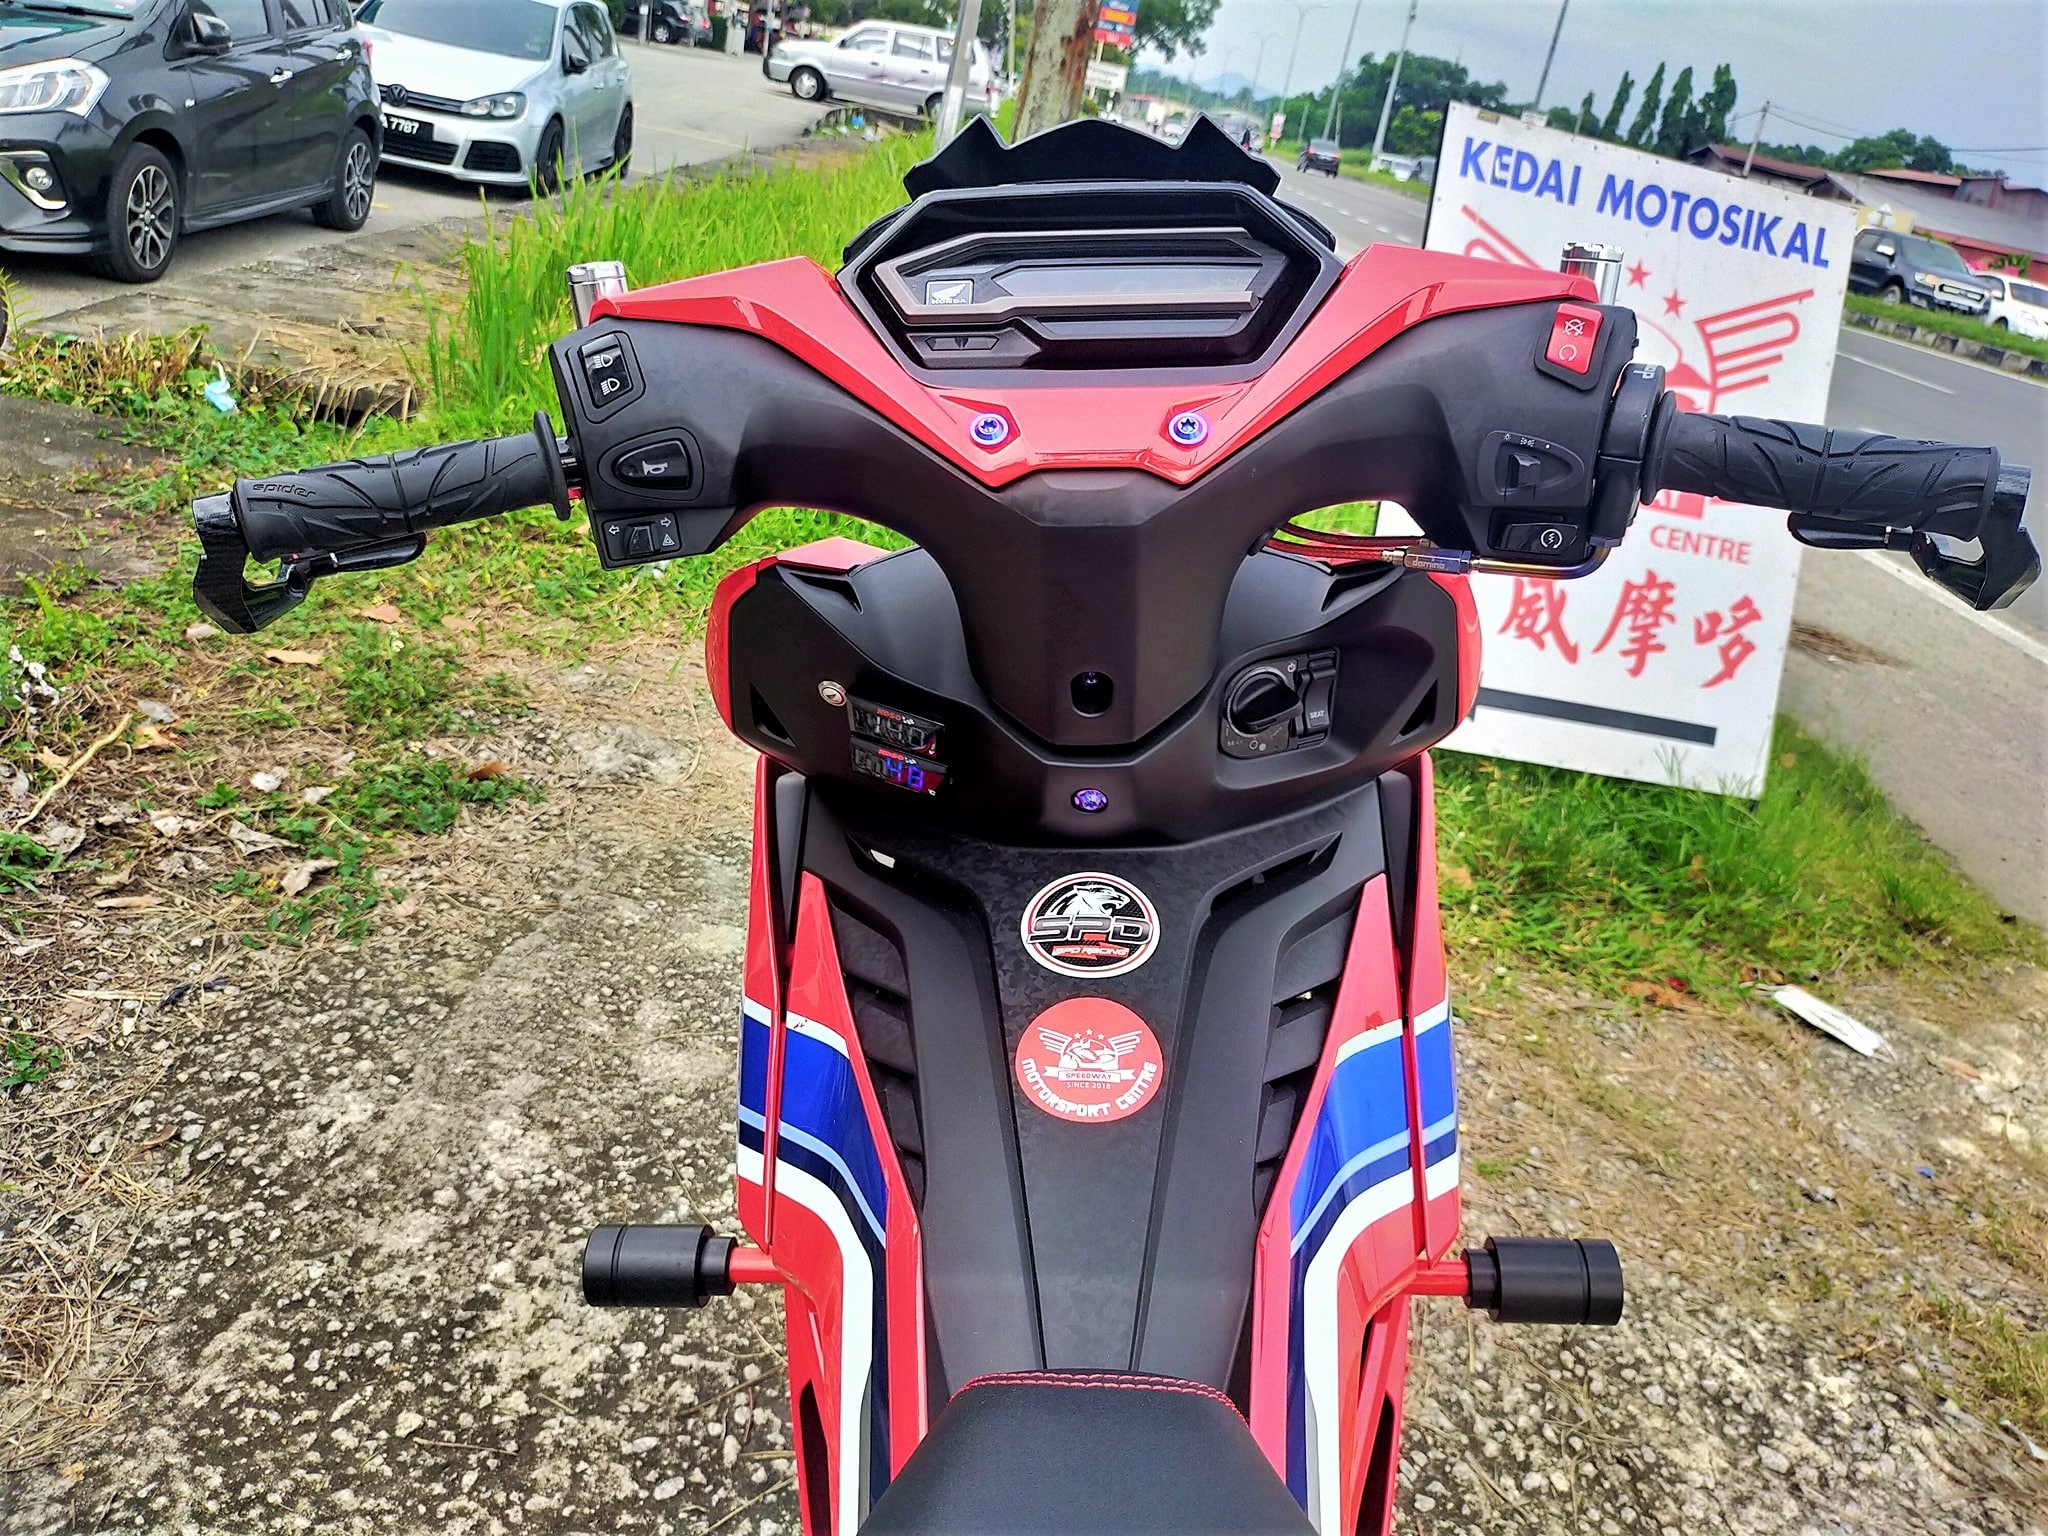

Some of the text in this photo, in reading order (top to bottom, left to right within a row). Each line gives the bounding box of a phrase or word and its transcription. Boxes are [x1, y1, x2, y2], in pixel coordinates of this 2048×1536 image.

[389, 118, 419, 134] 7787
[1459, 136, 1830, 269] KEDAI MOTOSIKAL
[1650, 526, 1752, 564] CENTRE
[1412, 556, 1446, 570] domino
[1310, 710, 1325, 719] SEAT
[886, 757, 925, 790] 48
[1026, 914, 1154, 945] SPD
[1053, 945, 1128, 957] SPD RACING
[1065, 1072, 1112, 1081] SPEEDWAY
[1021, 1058, 1158, 1118] MOTORSPORT CENTRE
[1066, 1081, 1111, 1090] SINCE 2018
